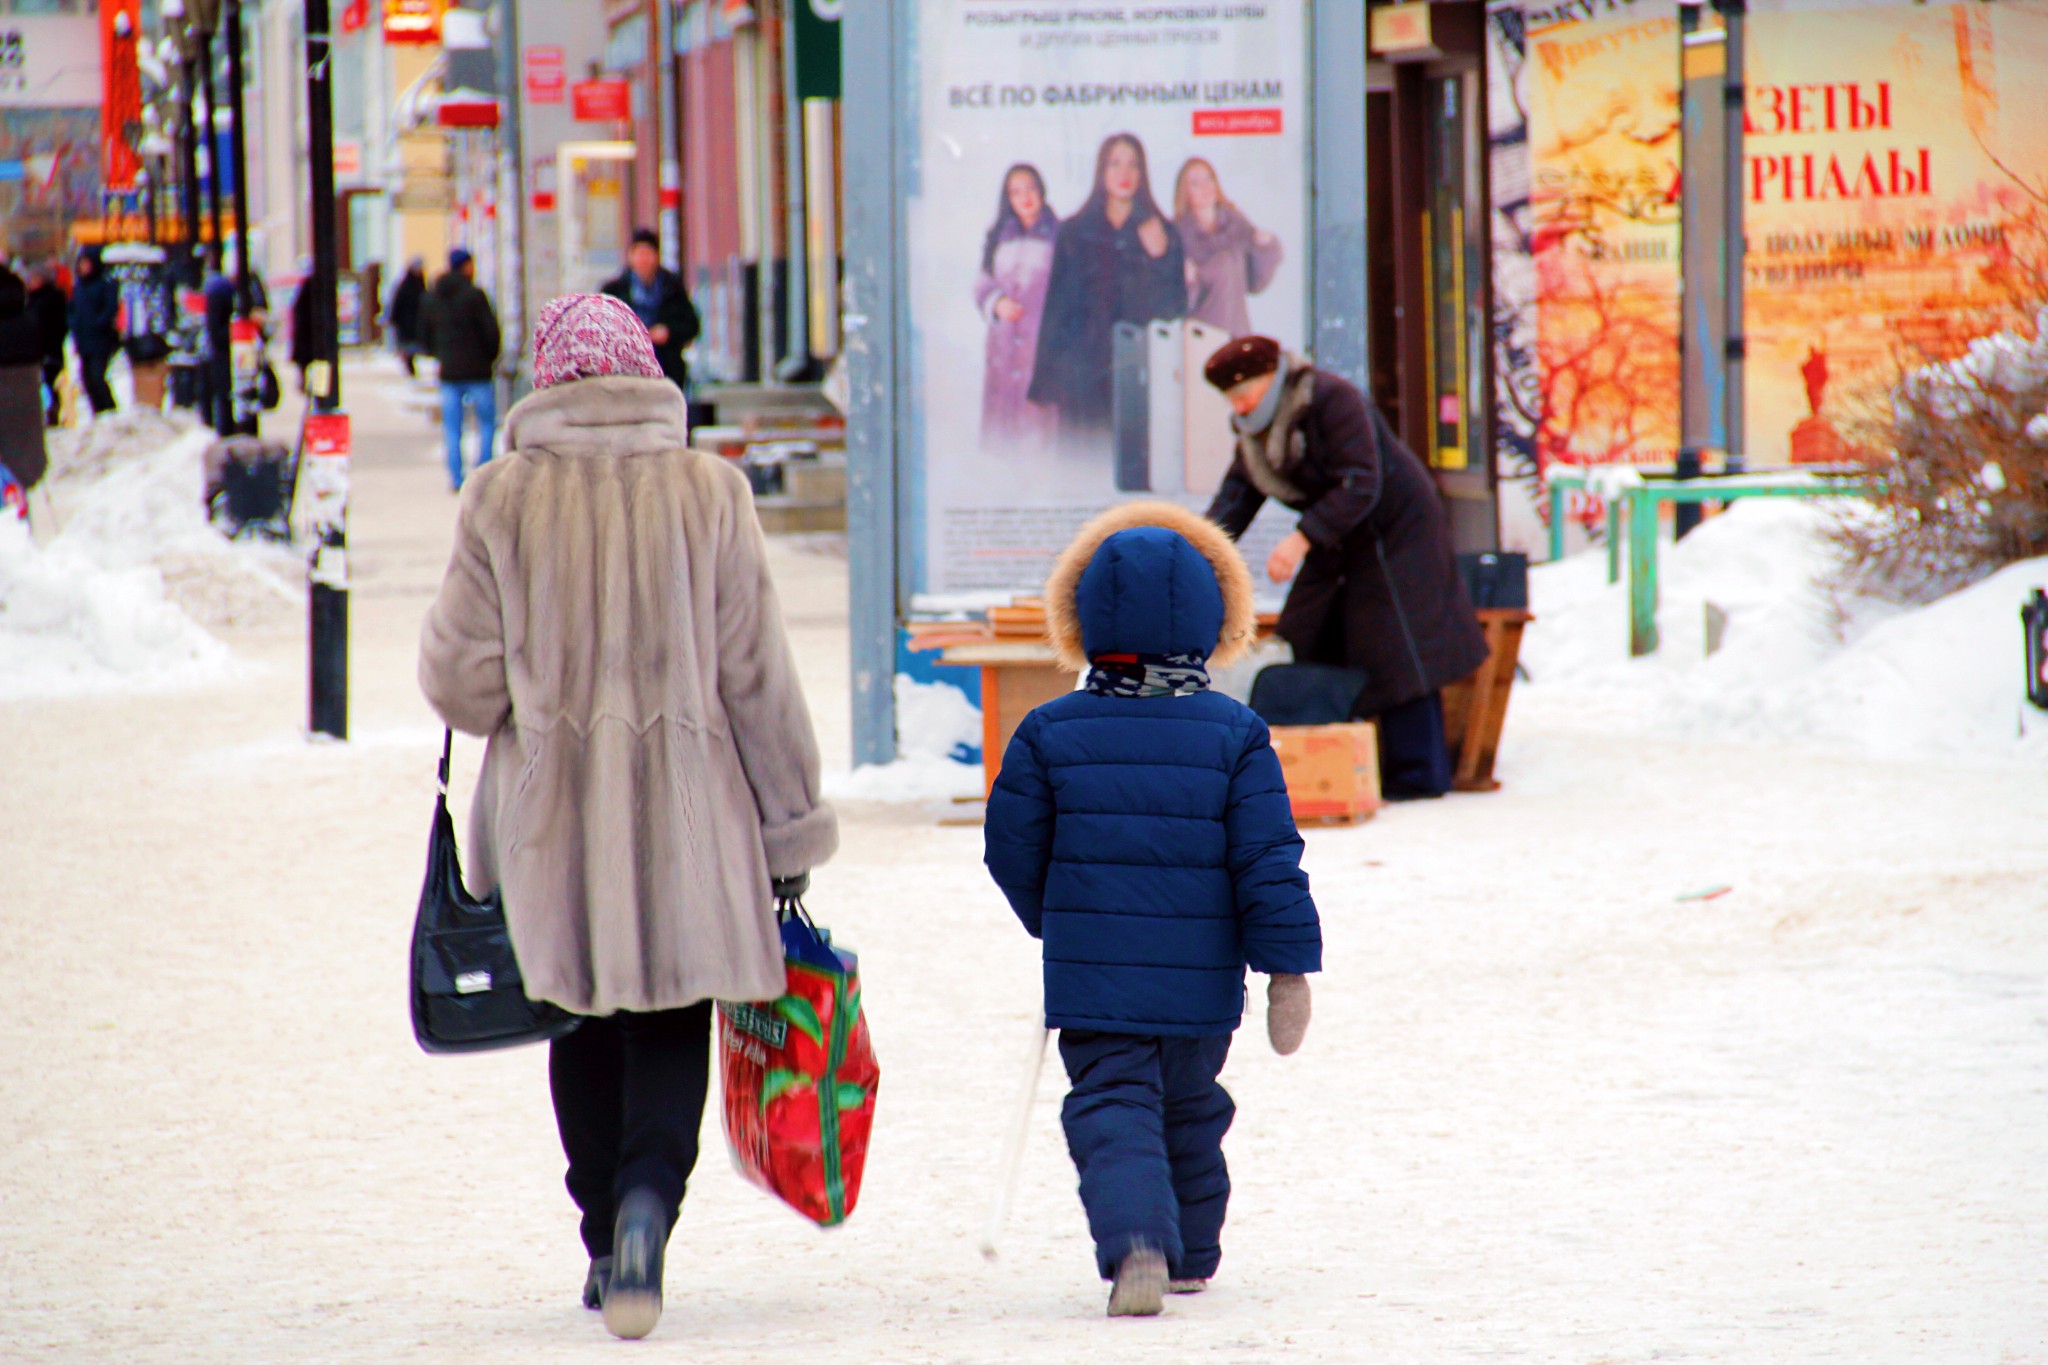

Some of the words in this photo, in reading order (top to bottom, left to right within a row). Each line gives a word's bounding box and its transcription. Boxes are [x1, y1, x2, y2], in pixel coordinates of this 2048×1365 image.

[949, 83, 993, 108] ВСЁ
[1001, 84, 1036, 107] ПО
[1041, 80, 1198, 108] ФАБРИЧНЫМ
[1203, 79, 1283, 105] ЦЕНАМ
